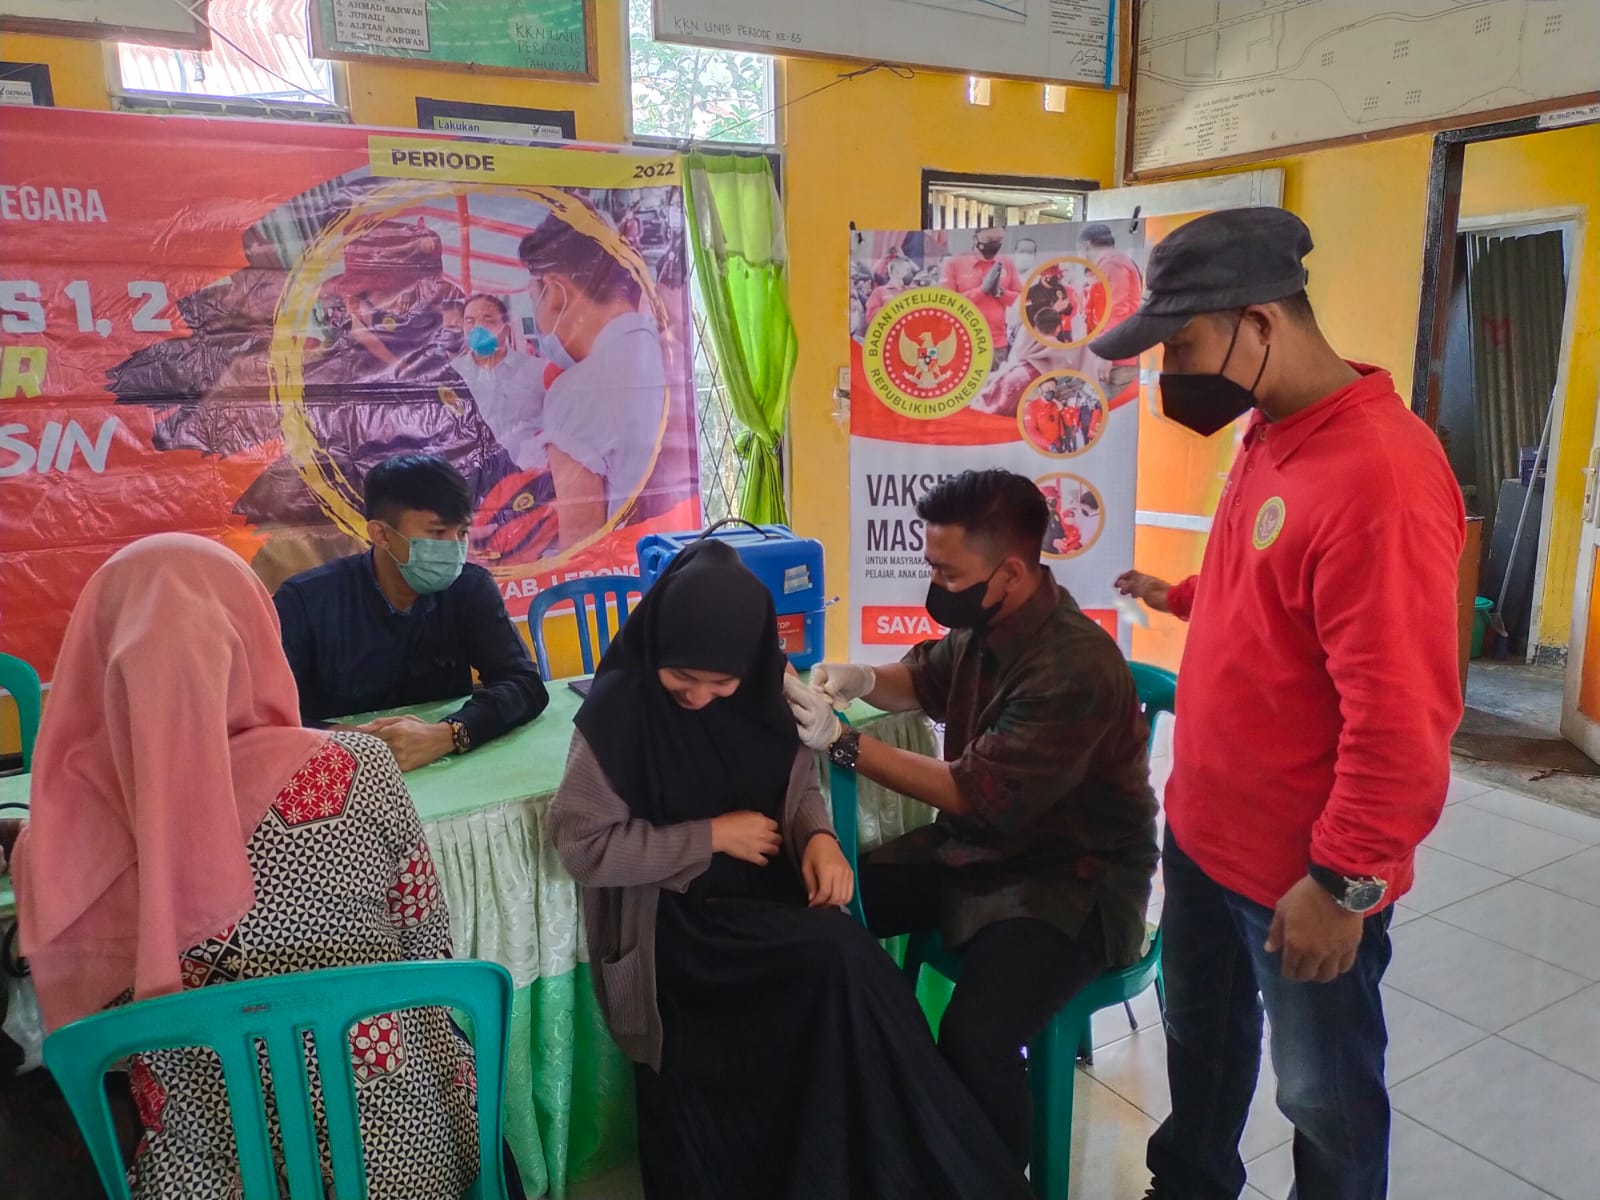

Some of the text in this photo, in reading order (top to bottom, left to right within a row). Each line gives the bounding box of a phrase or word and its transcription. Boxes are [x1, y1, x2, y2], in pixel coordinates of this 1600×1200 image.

[348, 1, 382, 12] AHMAD
[673, 15, 699, 31] KKN
[737, 24, 771, 40] PERIODE
[437, 119, 480, 133] Lakukan
[391, 149, 496, 172] PERIODE
[633, 162, 676, 179] 2022
[127, 280, 173, 332] 2
[868, 292, 987, 357] BADAN INTELIJEN NEGARA
[870, 367, 985, 414] REPUBLIK INDONESIA
[865, 556, 888, 565] UNTUK
[865, 569, 897, 579] PELAJAR,
[898, 569, 917, 578] ANAK
[877, 615, 933, 635] SAYA
